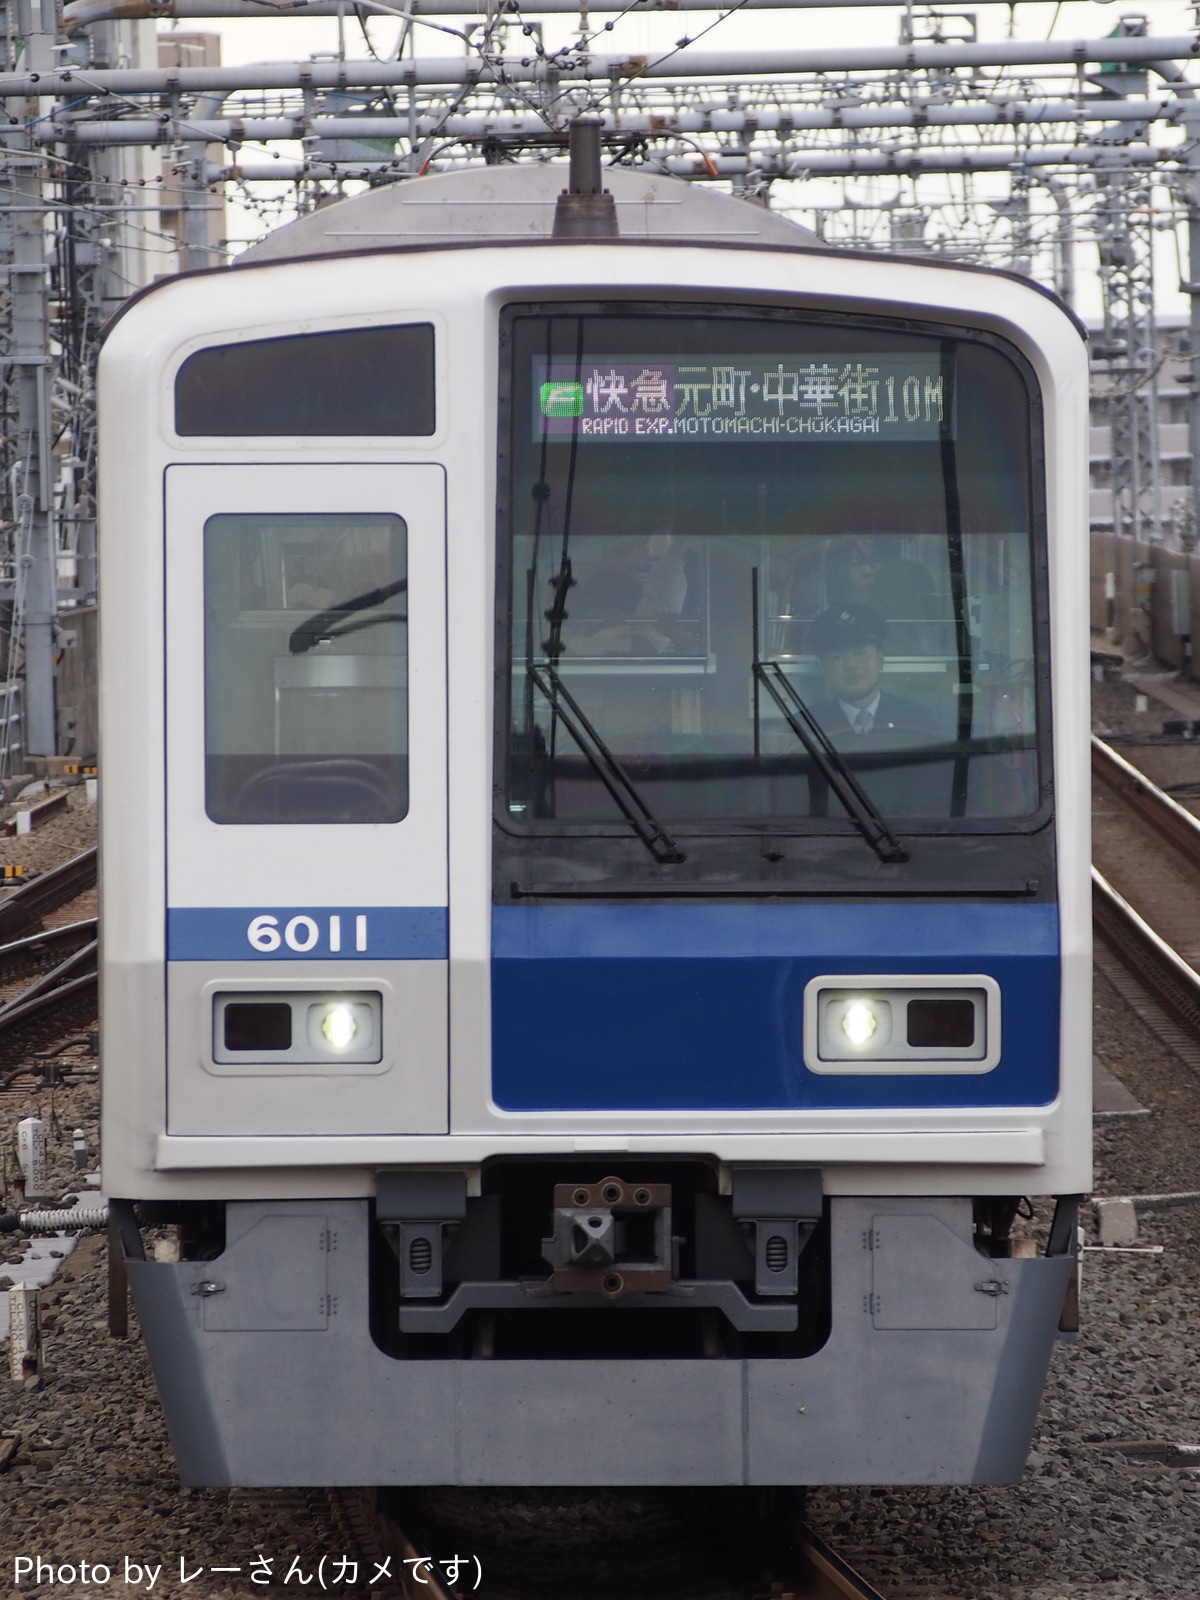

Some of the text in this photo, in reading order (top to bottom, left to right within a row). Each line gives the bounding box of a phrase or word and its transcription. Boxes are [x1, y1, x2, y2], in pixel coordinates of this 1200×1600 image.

[586, 369, 671, 413] 快急
[884, 375, 943, 421] 10M
[582, 417, 629, 434] RAPID
[635, 417, 674, 434] EXP.
[247, 915, 367, 952] 6011
